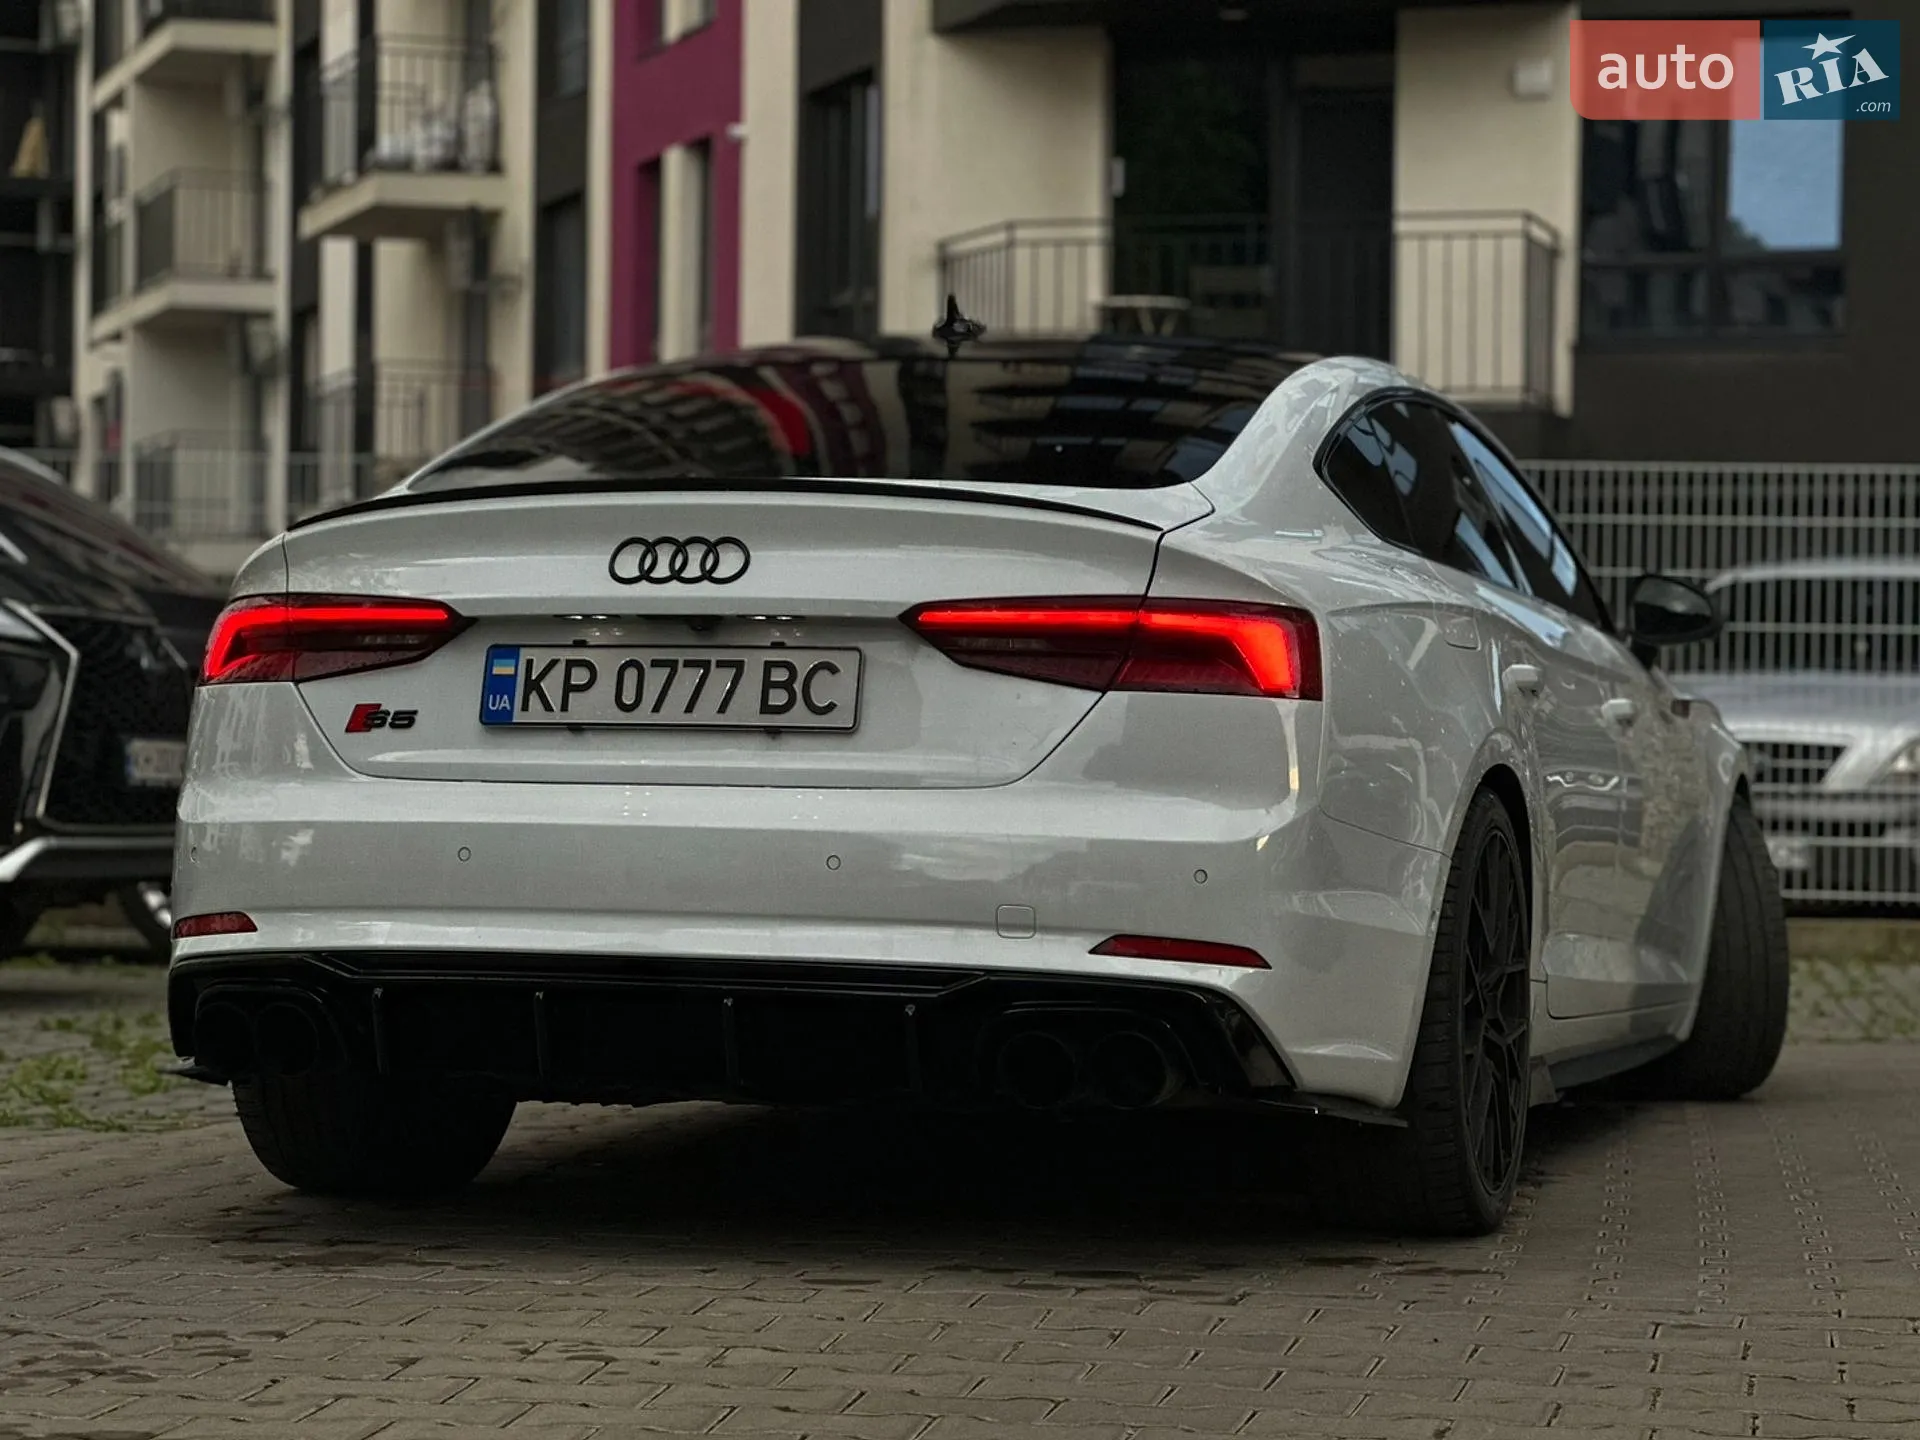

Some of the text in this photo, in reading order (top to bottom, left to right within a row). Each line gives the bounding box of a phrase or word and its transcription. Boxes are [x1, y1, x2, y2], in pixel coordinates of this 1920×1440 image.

[488, 694, 511, 711] UA
[520, 658, 841, 716] KP 0777 BC
